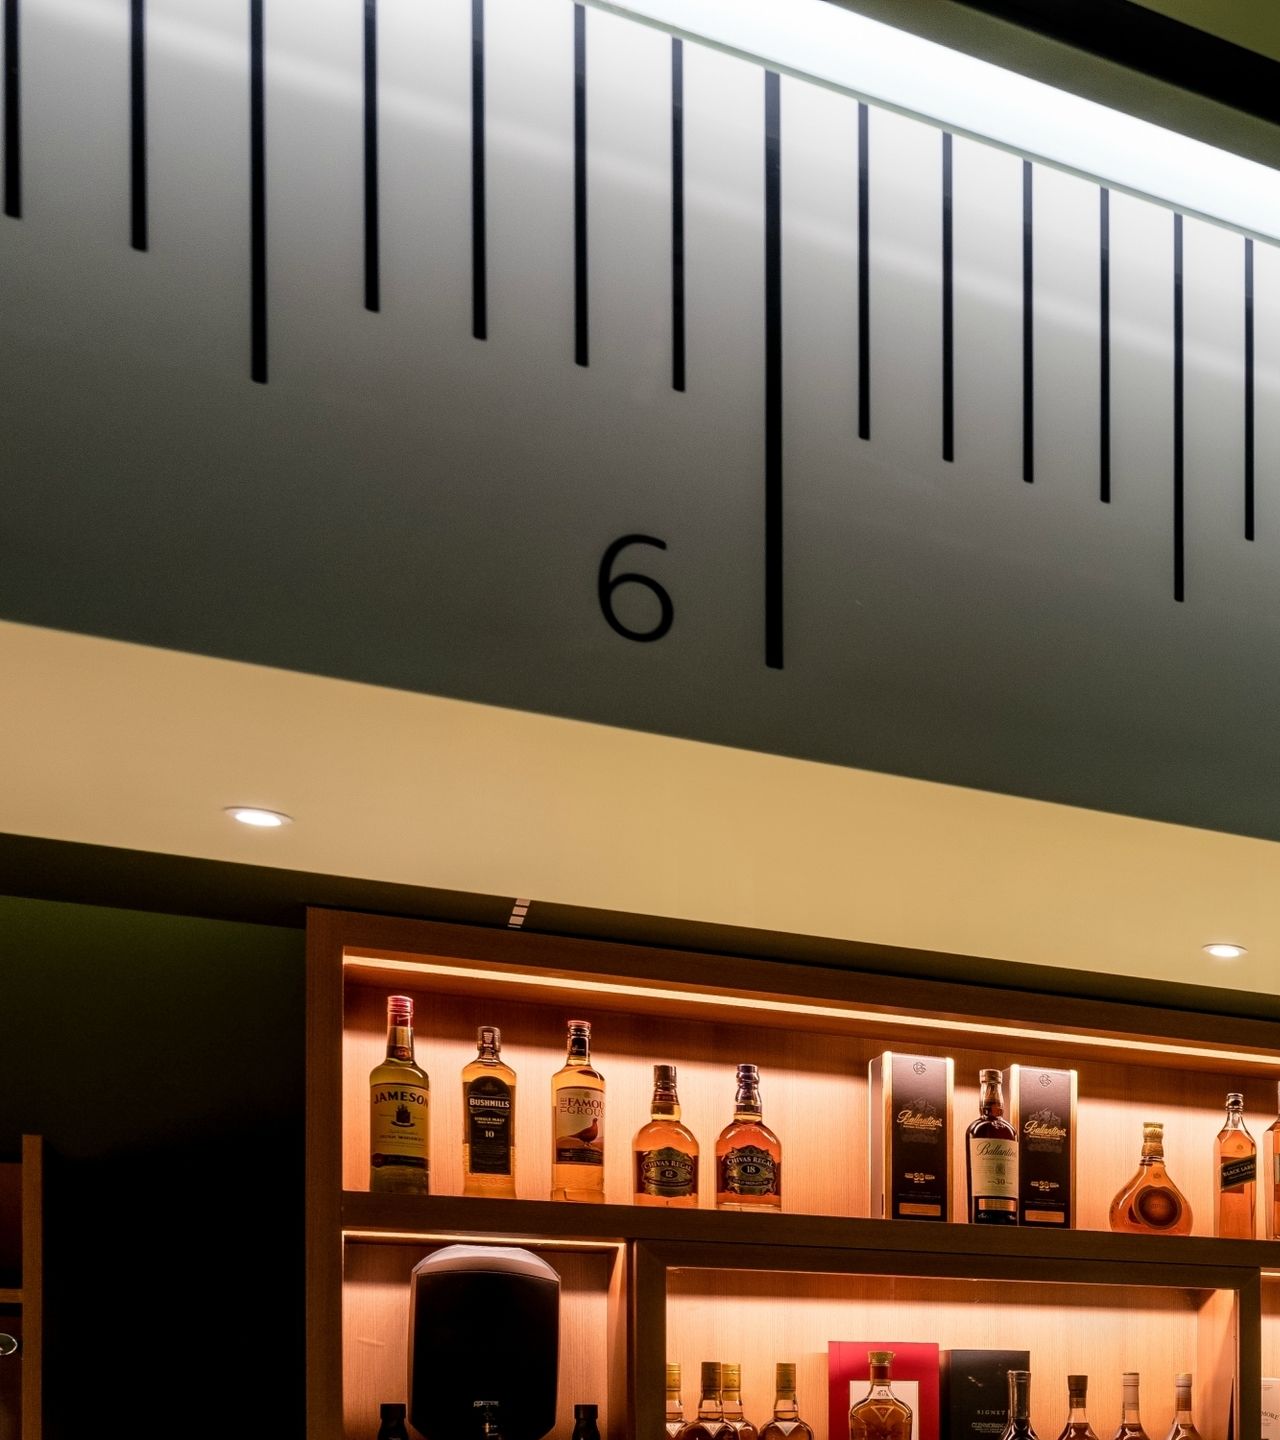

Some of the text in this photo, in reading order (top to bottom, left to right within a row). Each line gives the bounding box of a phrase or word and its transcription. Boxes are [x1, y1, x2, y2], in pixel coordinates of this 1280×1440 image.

[597, 533, 675, 643] 6
[469, 1098, 510, 1108] BUSHMILLS
[485, 1130, 494, 1138] 10
[644, 1159, 692, 1172] CHIVAS REGAL
[727, 1156, 774, 1167] CHIVAS REGAL
[746, 1165, 755, 1173] 18
[1222, 1168, 1240, 1177] BLACK
[1261, 1411, 1280, 1420] MORE
